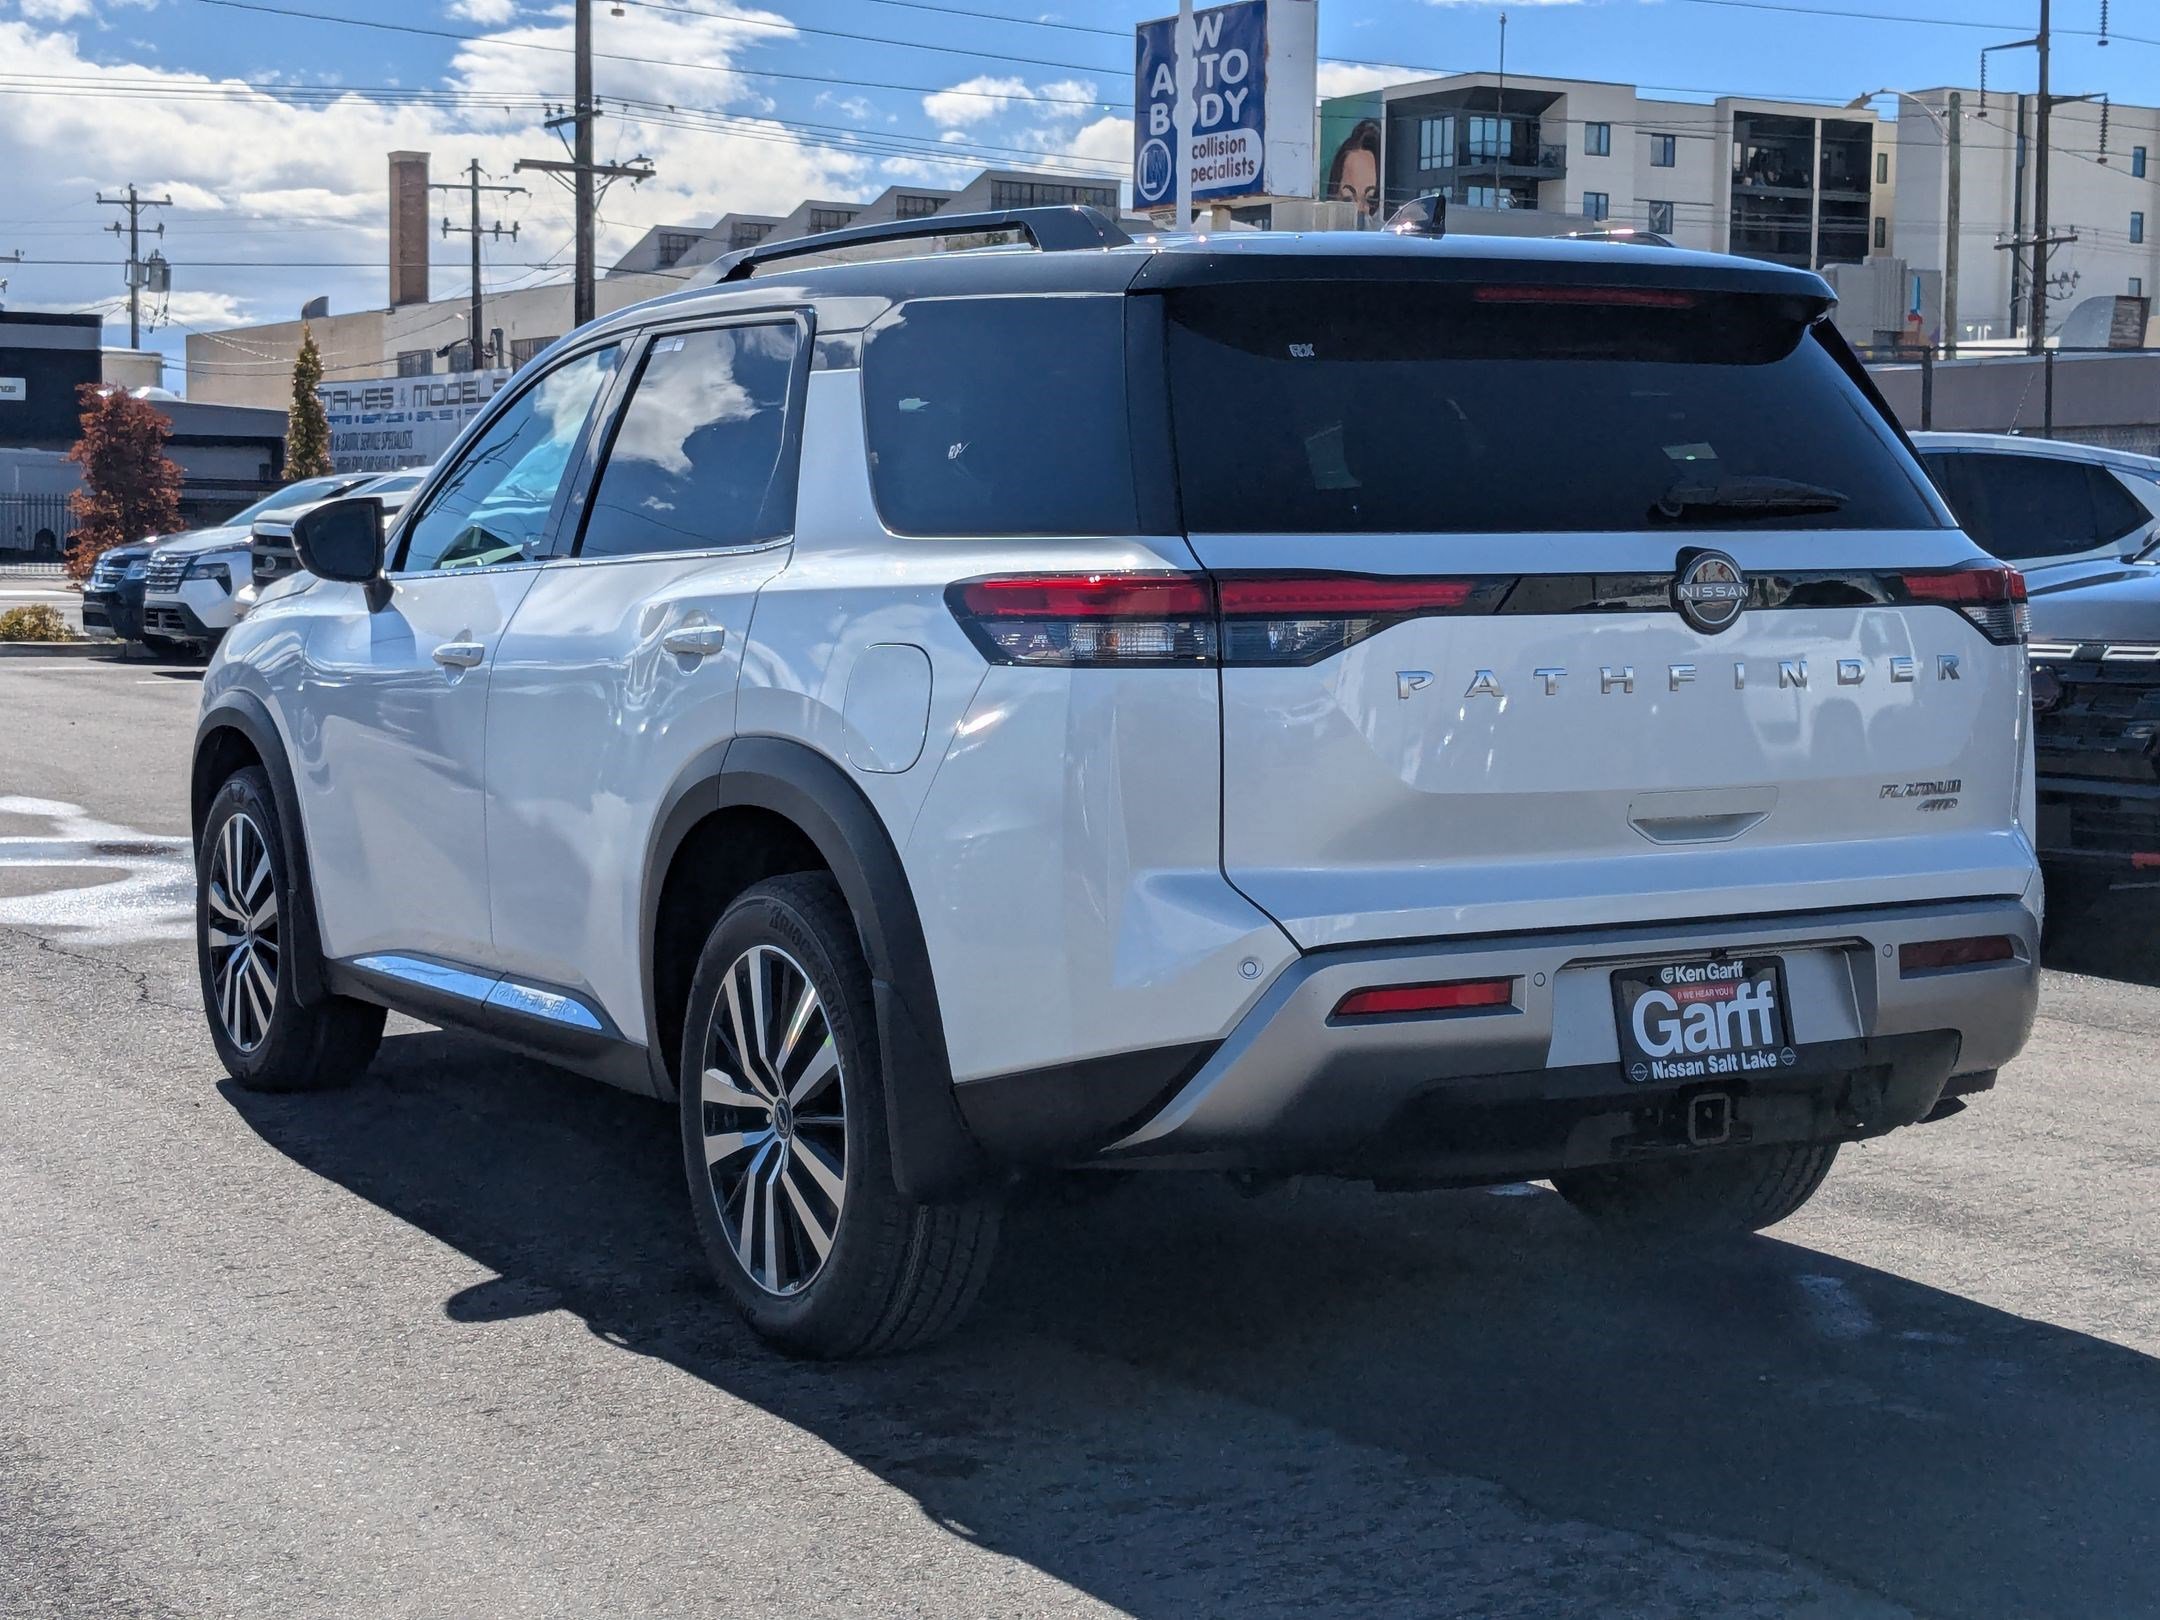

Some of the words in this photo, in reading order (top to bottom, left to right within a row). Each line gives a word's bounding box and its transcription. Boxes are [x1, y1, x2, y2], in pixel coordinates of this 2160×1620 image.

[1191, 134, 1247, 160] collision
[1191, 157, 1255, 184] pecialists
[1680, 585, 1749, 598] NISSAN
[1395, 653, 1962, 700] PATHFINDER
[1674, 965, 1706, 983] Ken
[1706, 960, 1744, 981] Garff
[1682, 991, 1695, 999] WE
[1695, 988, 1715, 998] HEAR
[1714, 986, 1729, 997] YOU
[1632, 980, 1775, 1058] Garff
[1651, 1060, 1705, 1080] Nissan
[1708, 1052, 1739, 1074] Salt
[1741, 1050, 1778, 1071] Lake
